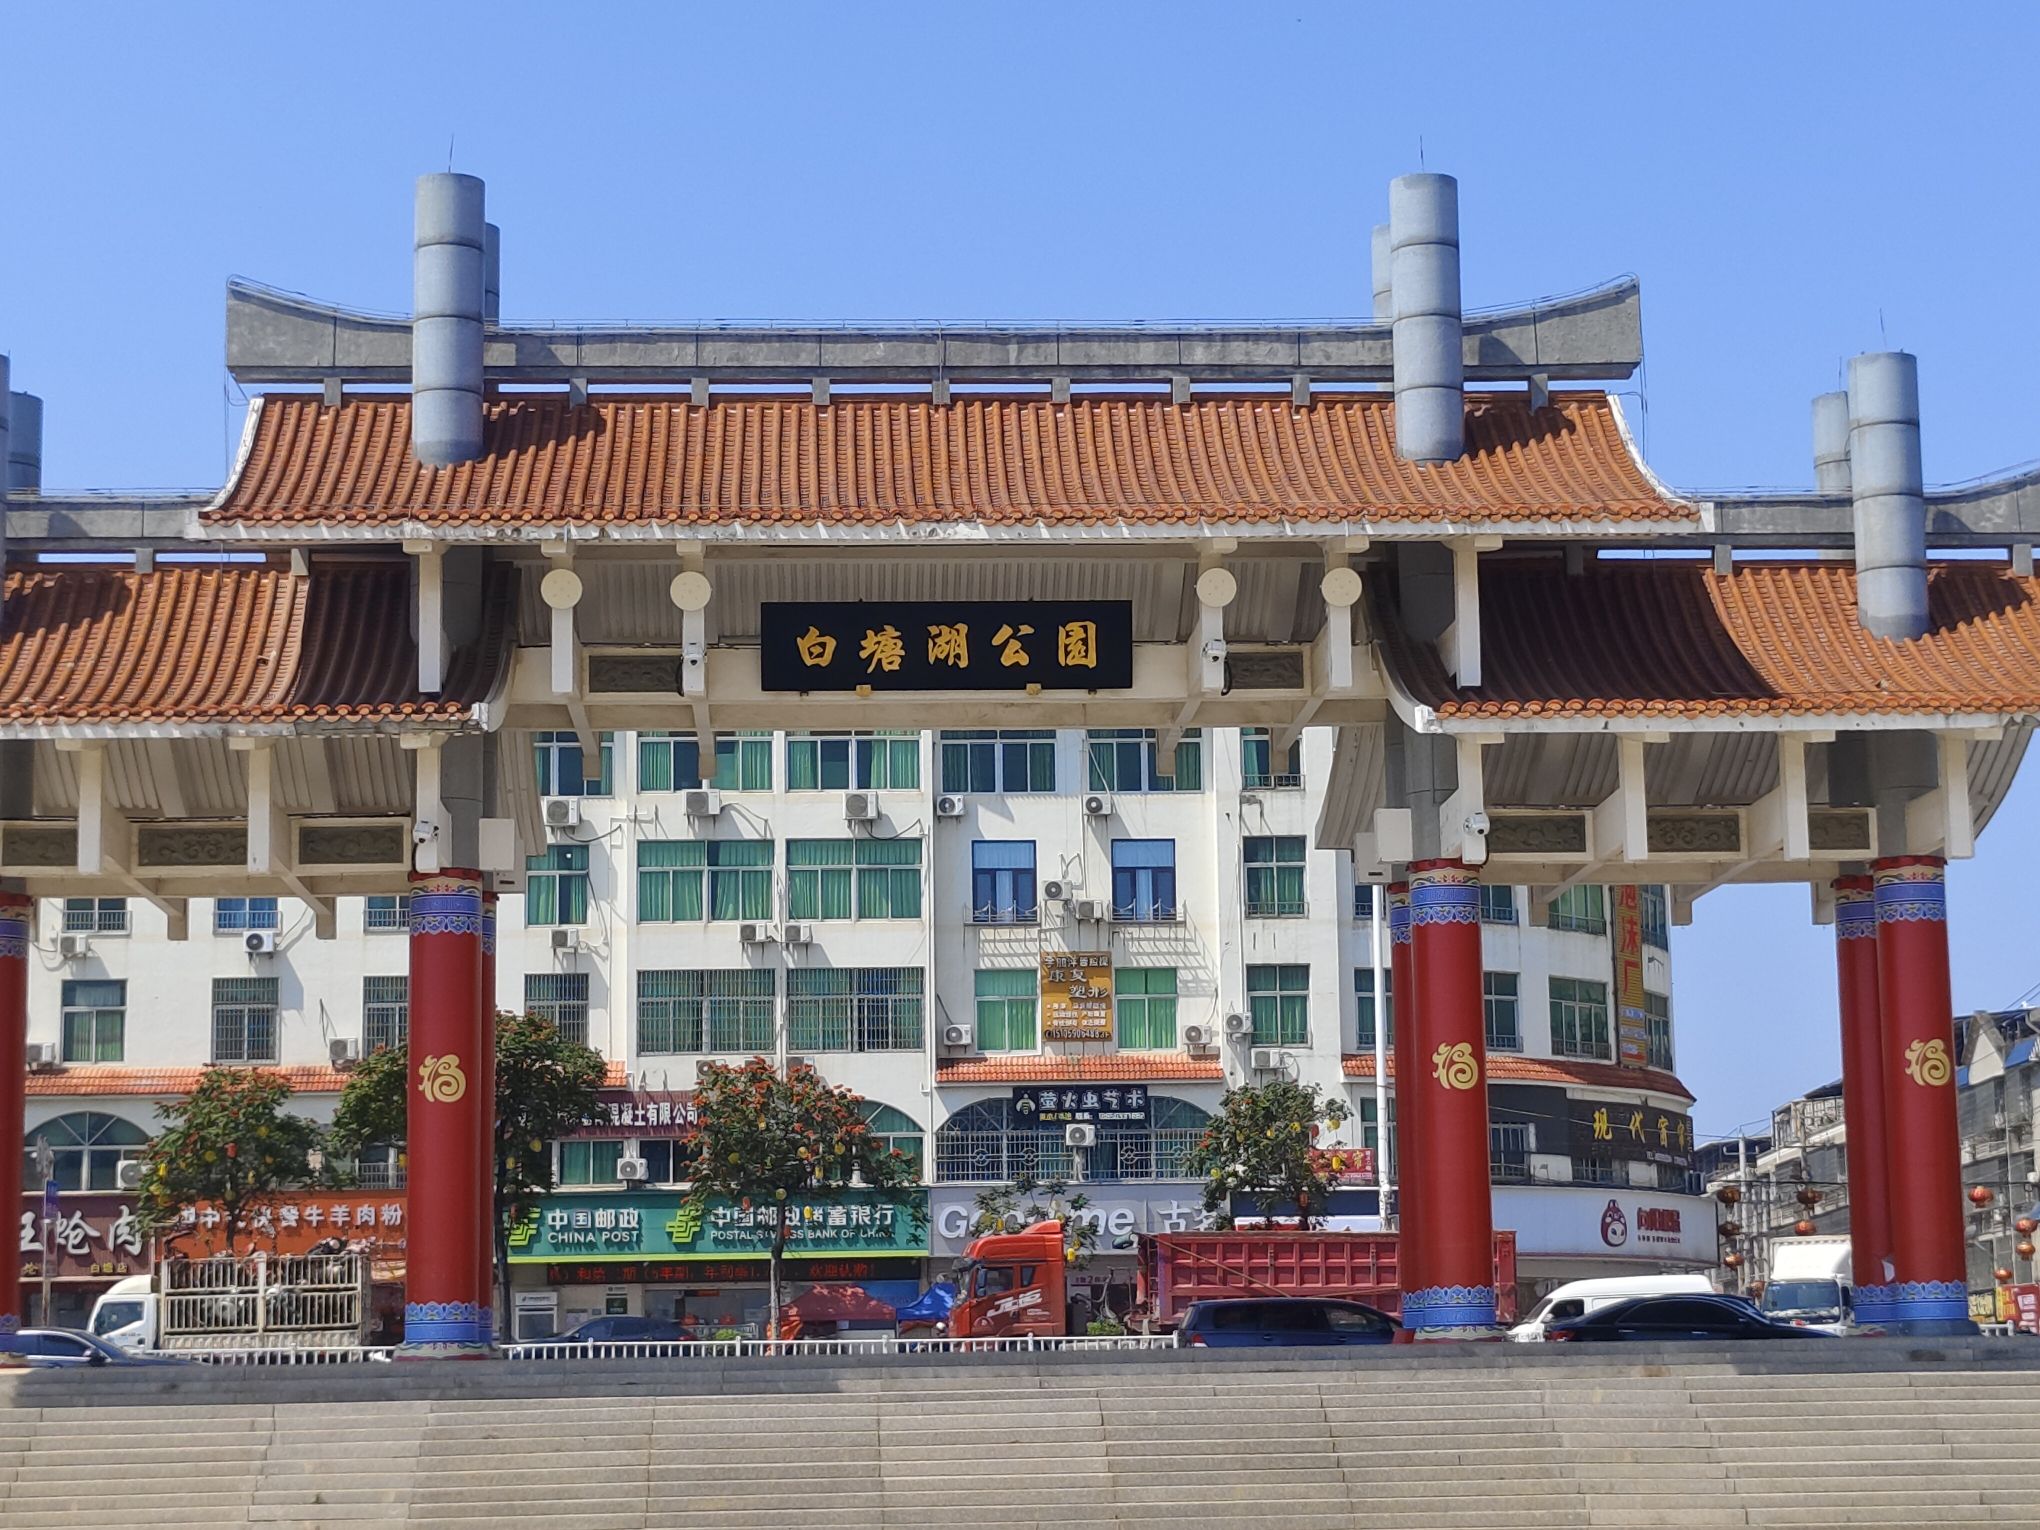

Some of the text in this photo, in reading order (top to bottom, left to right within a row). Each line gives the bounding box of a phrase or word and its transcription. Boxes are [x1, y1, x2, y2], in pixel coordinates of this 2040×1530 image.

[797, 621, 1097, 674] 白塘湖公園
[1048, 968, 1088, 982] 康复
[1069, 985, 1109, 998] 塑形
[1040, 1088, 1145, 1110] 萤火虫艺术
[547, 1208, 640, 1229] 中国邮政
[548, 1230, 639, 1243] CHINA POST
[711, 1229, 752, 1240] POSTAL
[808, 1229, 837, 1239] BANK
